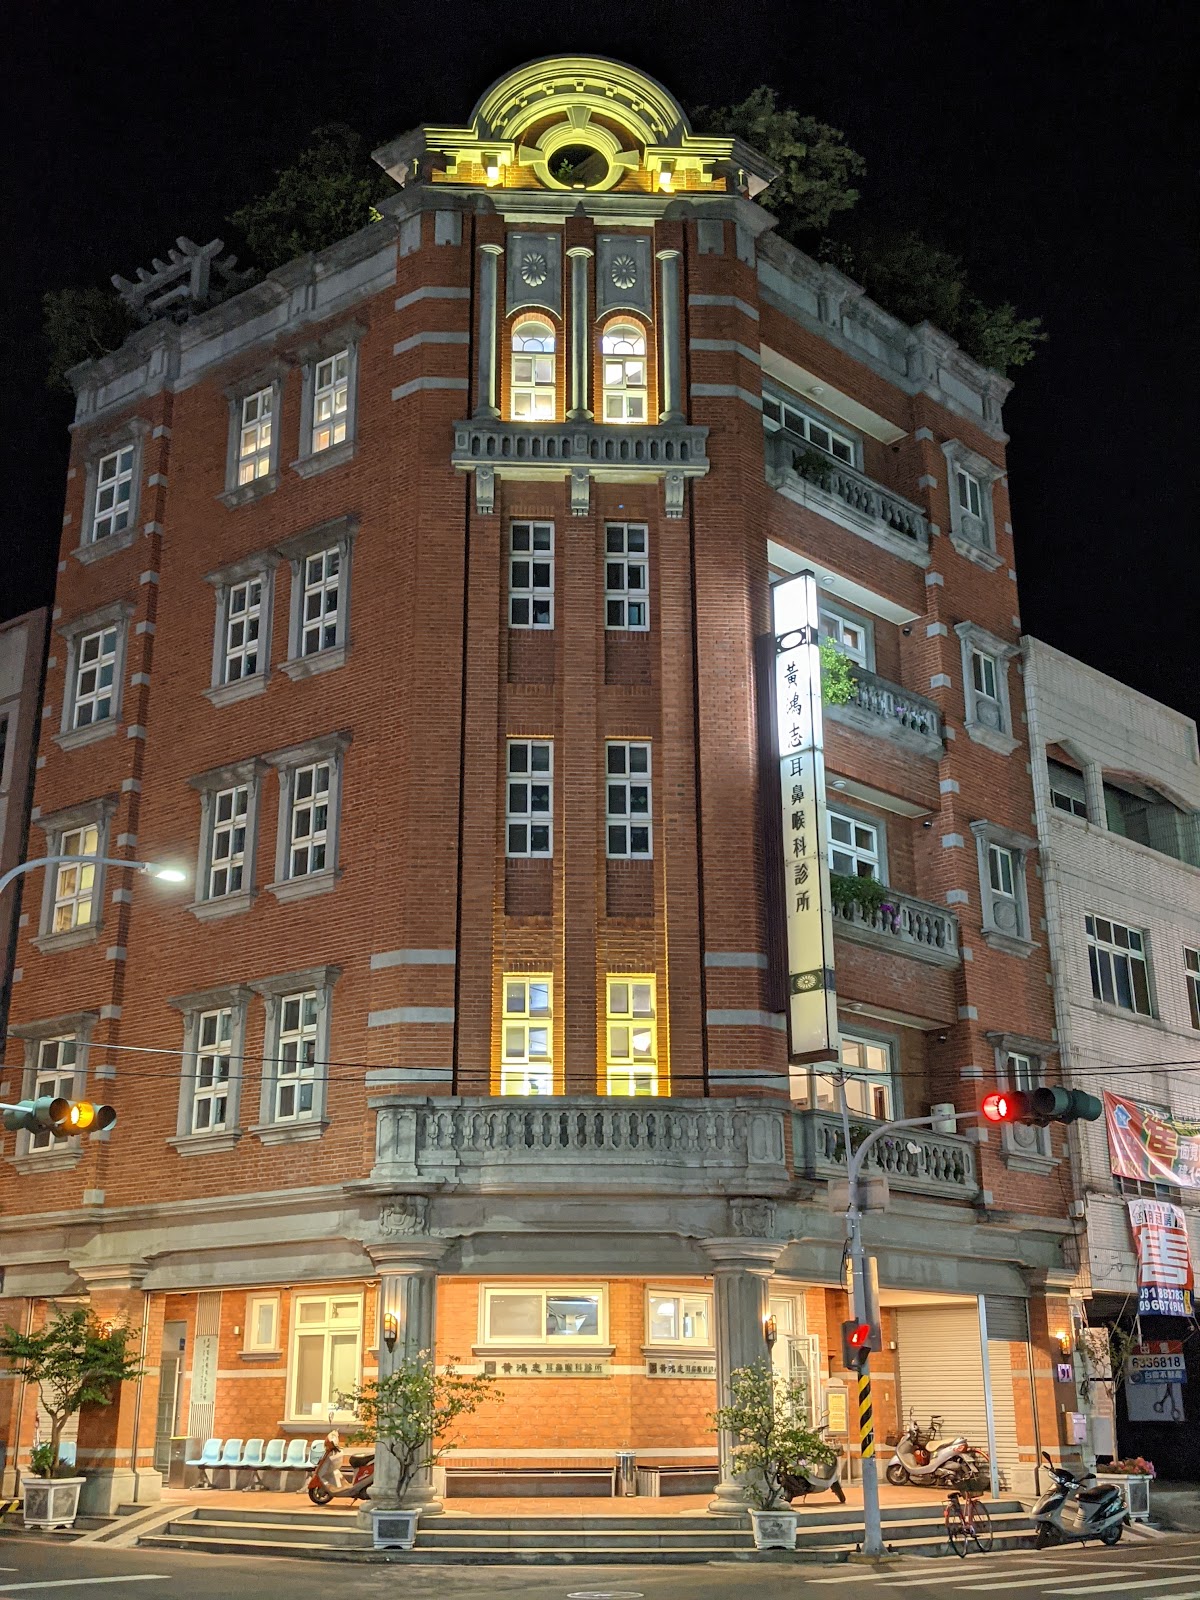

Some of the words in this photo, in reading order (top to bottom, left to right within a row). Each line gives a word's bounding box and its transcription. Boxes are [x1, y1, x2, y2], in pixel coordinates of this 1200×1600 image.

[784, 661, 810, 913] 黃鴻志耳鼻喉科診所
[1138, 1226, 1188, 1285] 售
